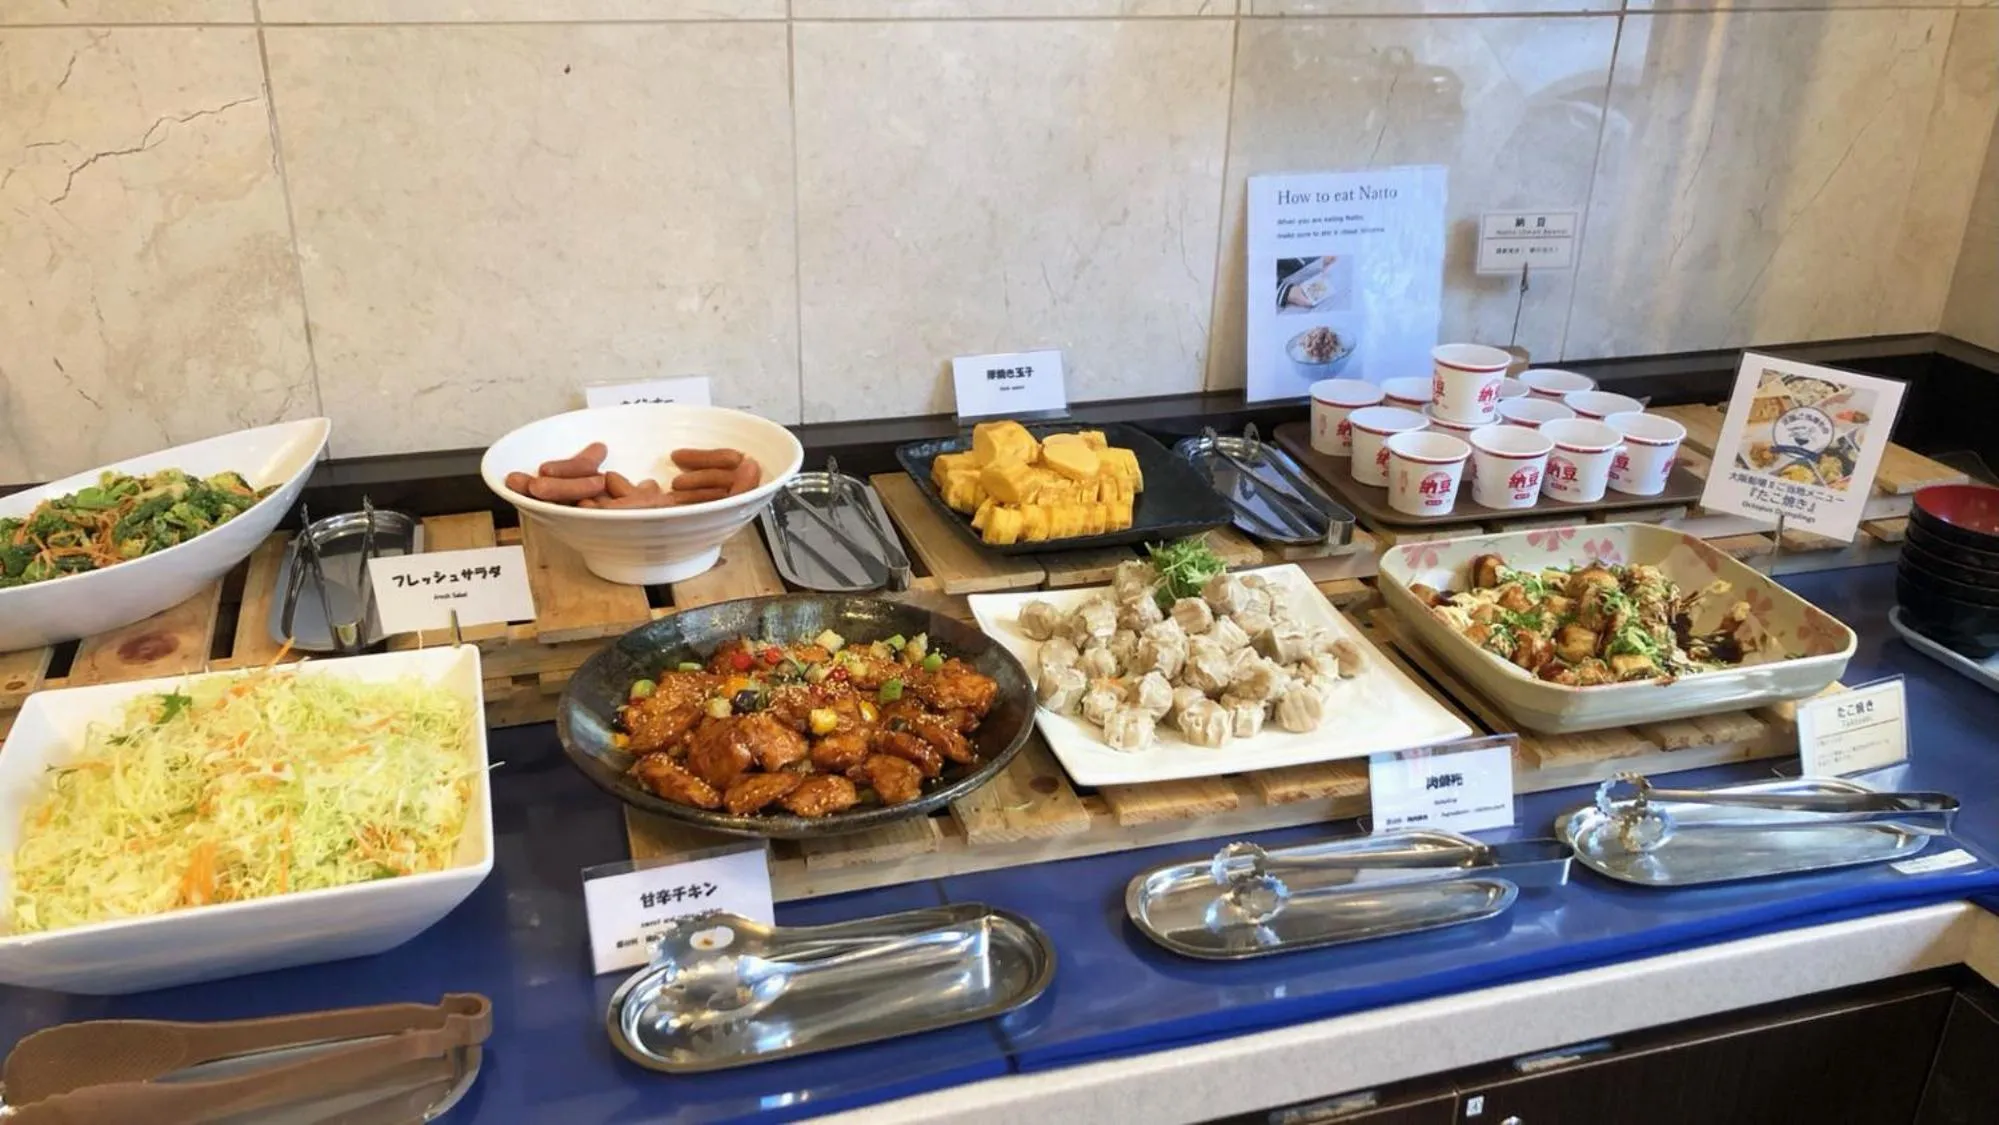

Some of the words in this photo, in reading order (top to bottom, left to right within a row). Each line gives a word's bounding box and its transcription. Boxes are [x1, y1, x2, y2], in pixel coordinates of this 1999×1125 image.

[1278, 189, 1311, 205] How
[1316, 191, 1330, 203] to
[1334, 189, 1354, 202] eat
[1359, 184, 1398, 201] Natto
[1420, 478, 1452, 495] 納豆
[1508, 470, 1539, 489] 納豆
[392, 565, 501, 588] フレッシュサラダ
[640, 882, 717, 908] 甘辛チキン
